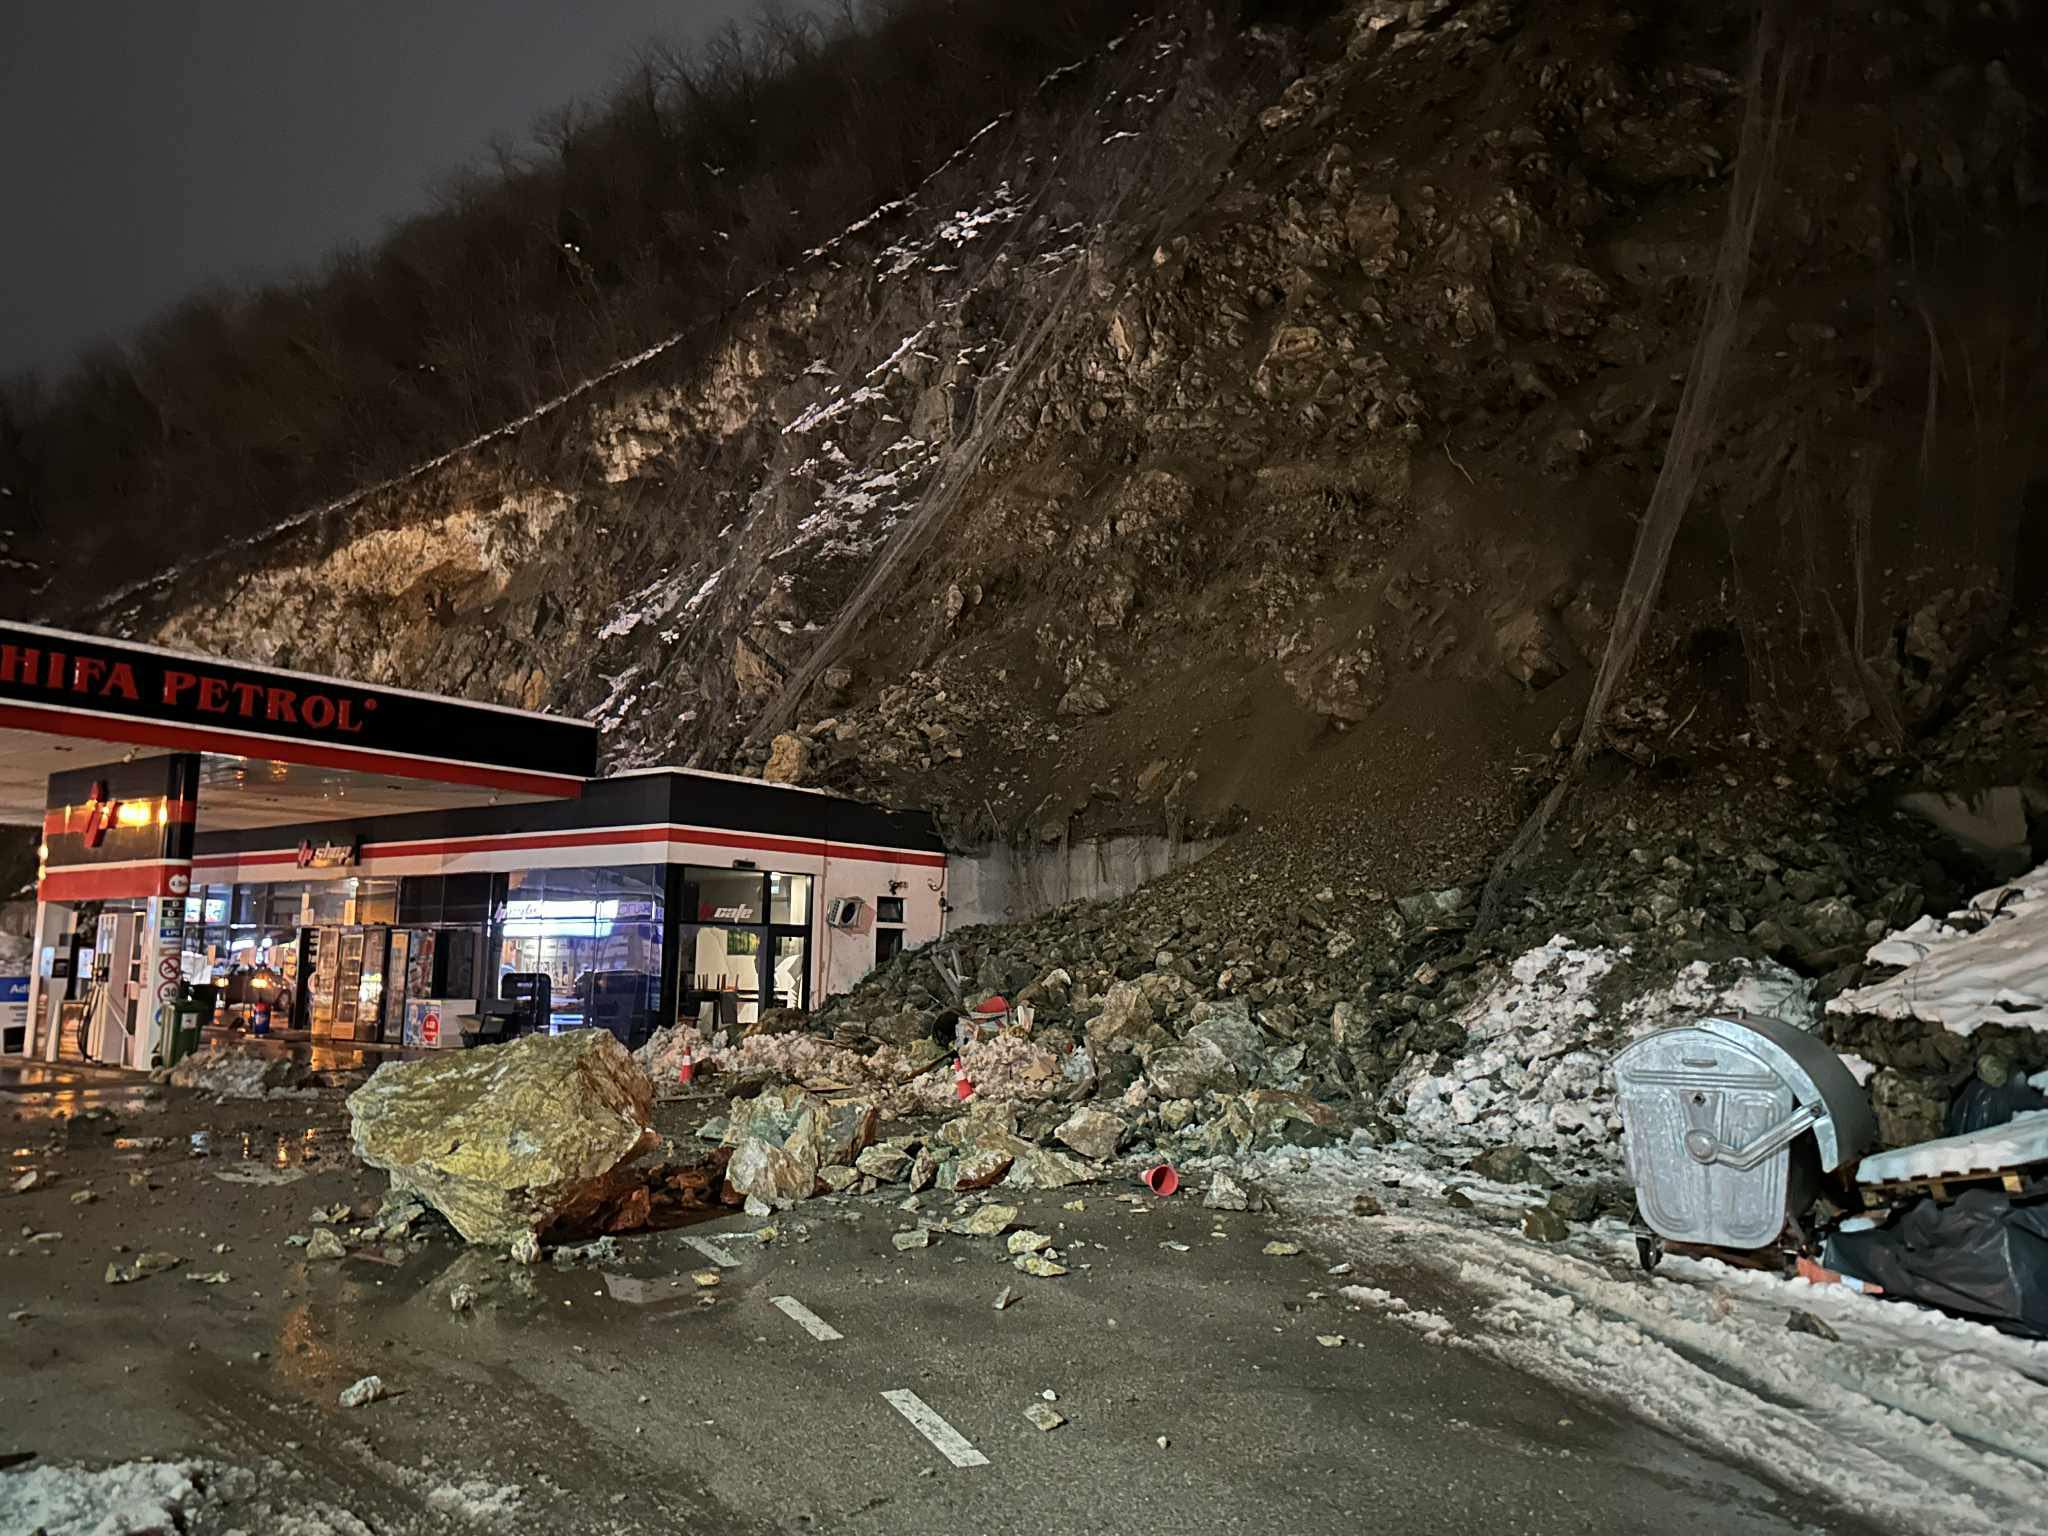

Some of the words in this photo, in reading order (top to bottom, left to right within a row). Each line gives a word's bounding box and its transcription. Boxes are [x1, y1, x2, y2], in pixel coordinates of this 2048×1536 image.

[1, 643, 139, 700] HIFA
[162, 670, 364, 732] PETROL
[163, 986, 176, 997] 30
